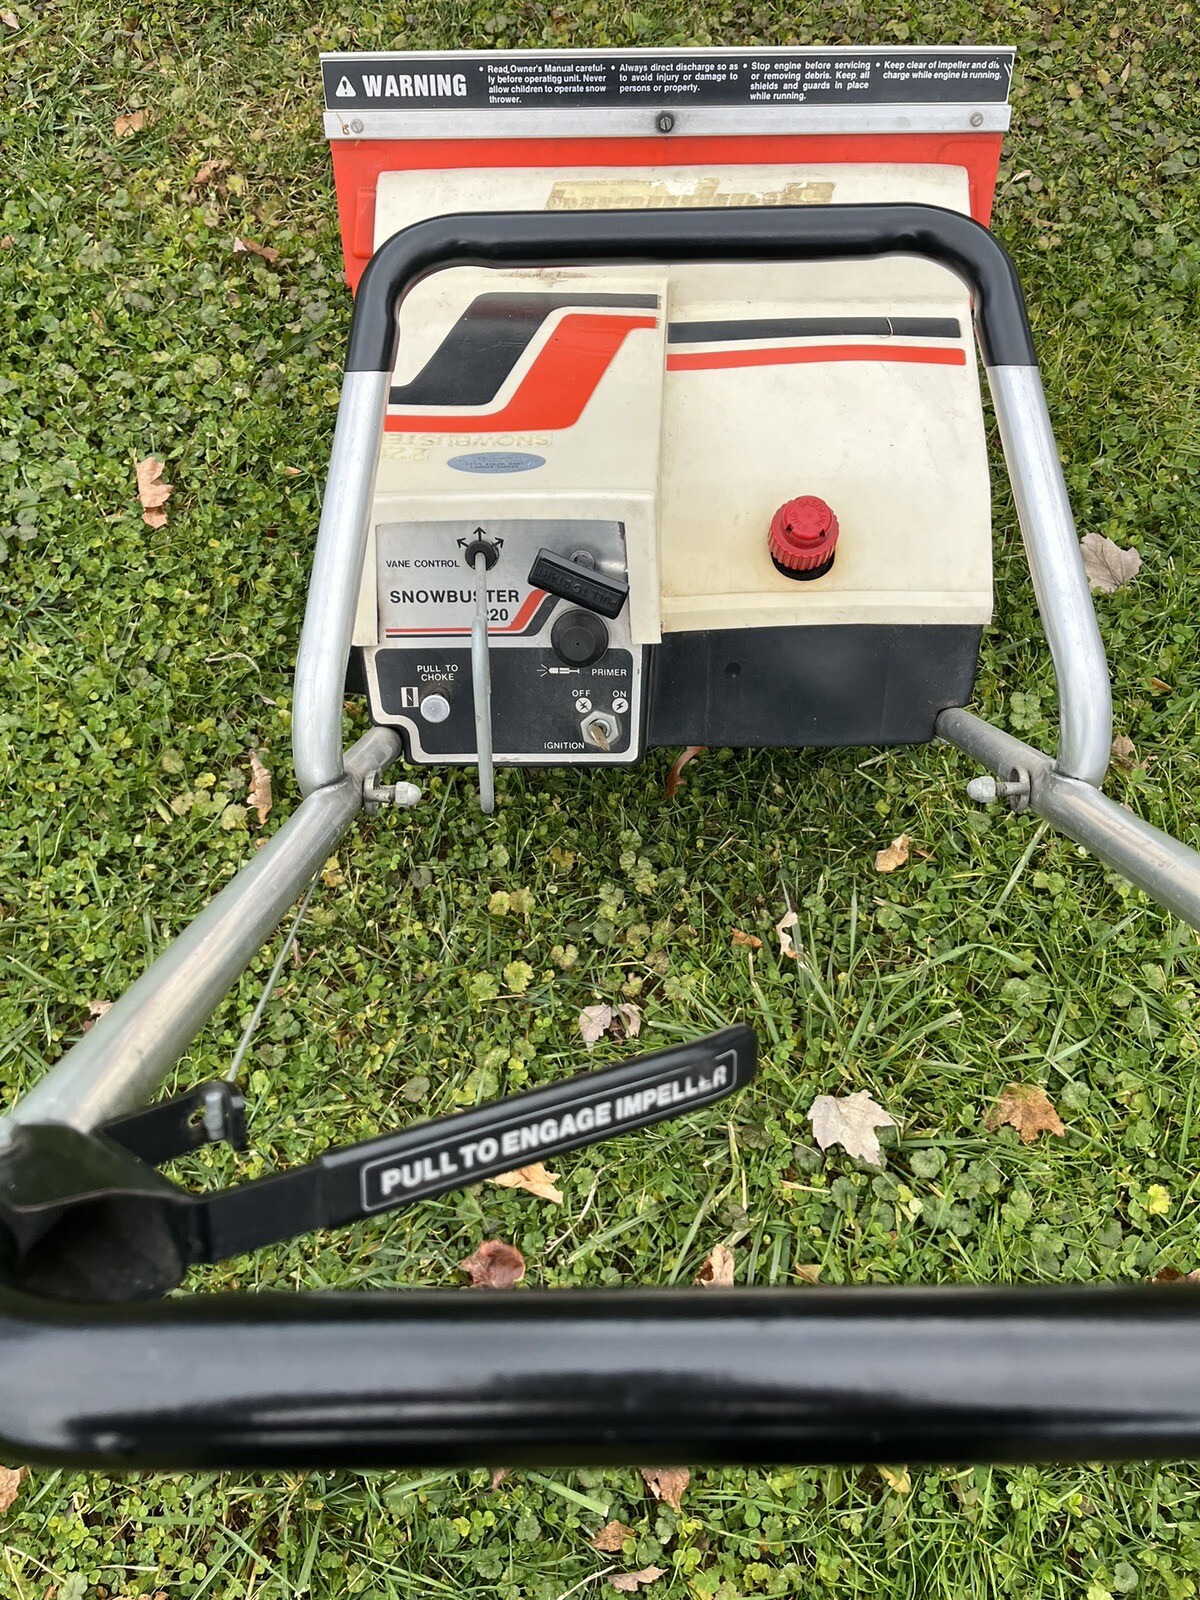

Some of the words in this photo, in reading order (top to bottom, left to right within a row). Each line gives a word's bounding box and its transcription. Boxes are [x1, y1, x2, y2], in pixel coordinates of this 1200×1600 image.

[488, 65, 508, 73] Read
[545, 64, 573, 72] Manual
[575, 64, 606, 72] careful-
[620, 64, 647, 73] Always
[676, 63, 714, 72] discharge
[751, 62, 770, 71] Stop
[774, 62, 801, 71] engine
[805, 61, 831, 69] before
[834, 61, 871, 70] servicing
[884, 61, 905, 70] Keep
[907, 61, 926, 69] clear
[928, 61, 936, 69] of
[938, 60, 970, 70] impeller
[971, 60, 986, 69] and
[488, 76, 495, 85] ly
[497, 75, 522, 83] before
[524, 75, 562, 84] operating
[583, 74, 606, 82] Never
[631, 73, 652, 81] avoid
[656, 73, 679, 82] injury
[695, 73, 726, 82] damage
[730, 72, 738, 80] to
[751, 72, 759, 80] or
[764, 72, 800, 81] removing
[805, 71, 831, 79] debris.
[860, 71, 870, 79] all
[883, 71, 910, 80] charge
[912, 71, 932, 79] while
[934, 71, 960, 80] engine
[969, 70, 1001, 80] running.
[362, 74, 467, 97] WARNING
[511, 85, 543, 93] children
[554, 85, 584, 94] operate
[620, 85, 650, 93] persons
[664, 83, 700, 93] property.
[750, 82, 778, 90] shields
[803, 81, 830, 91] guards
[835, 81, 842, 89] in
[847, 81, 869, 90] place
[489, 95, 521, 103] thrower.
[750, 92, 771, 100] while
[773, 92, 806, 101] running.
[386, 560, 411, 568] VANE
[414, 559, 460, 568] CONTROL
[390, 590, 519, 603] SNOWBUTER
[445, 664, 458, 672] TO
[421, 673, 454, 681] CHOKE
[380, 1152, 457, 1195] PULL
[459, 1139, 499, 1168] TO
[502, 1105, 612, 1156] ENGAGE
